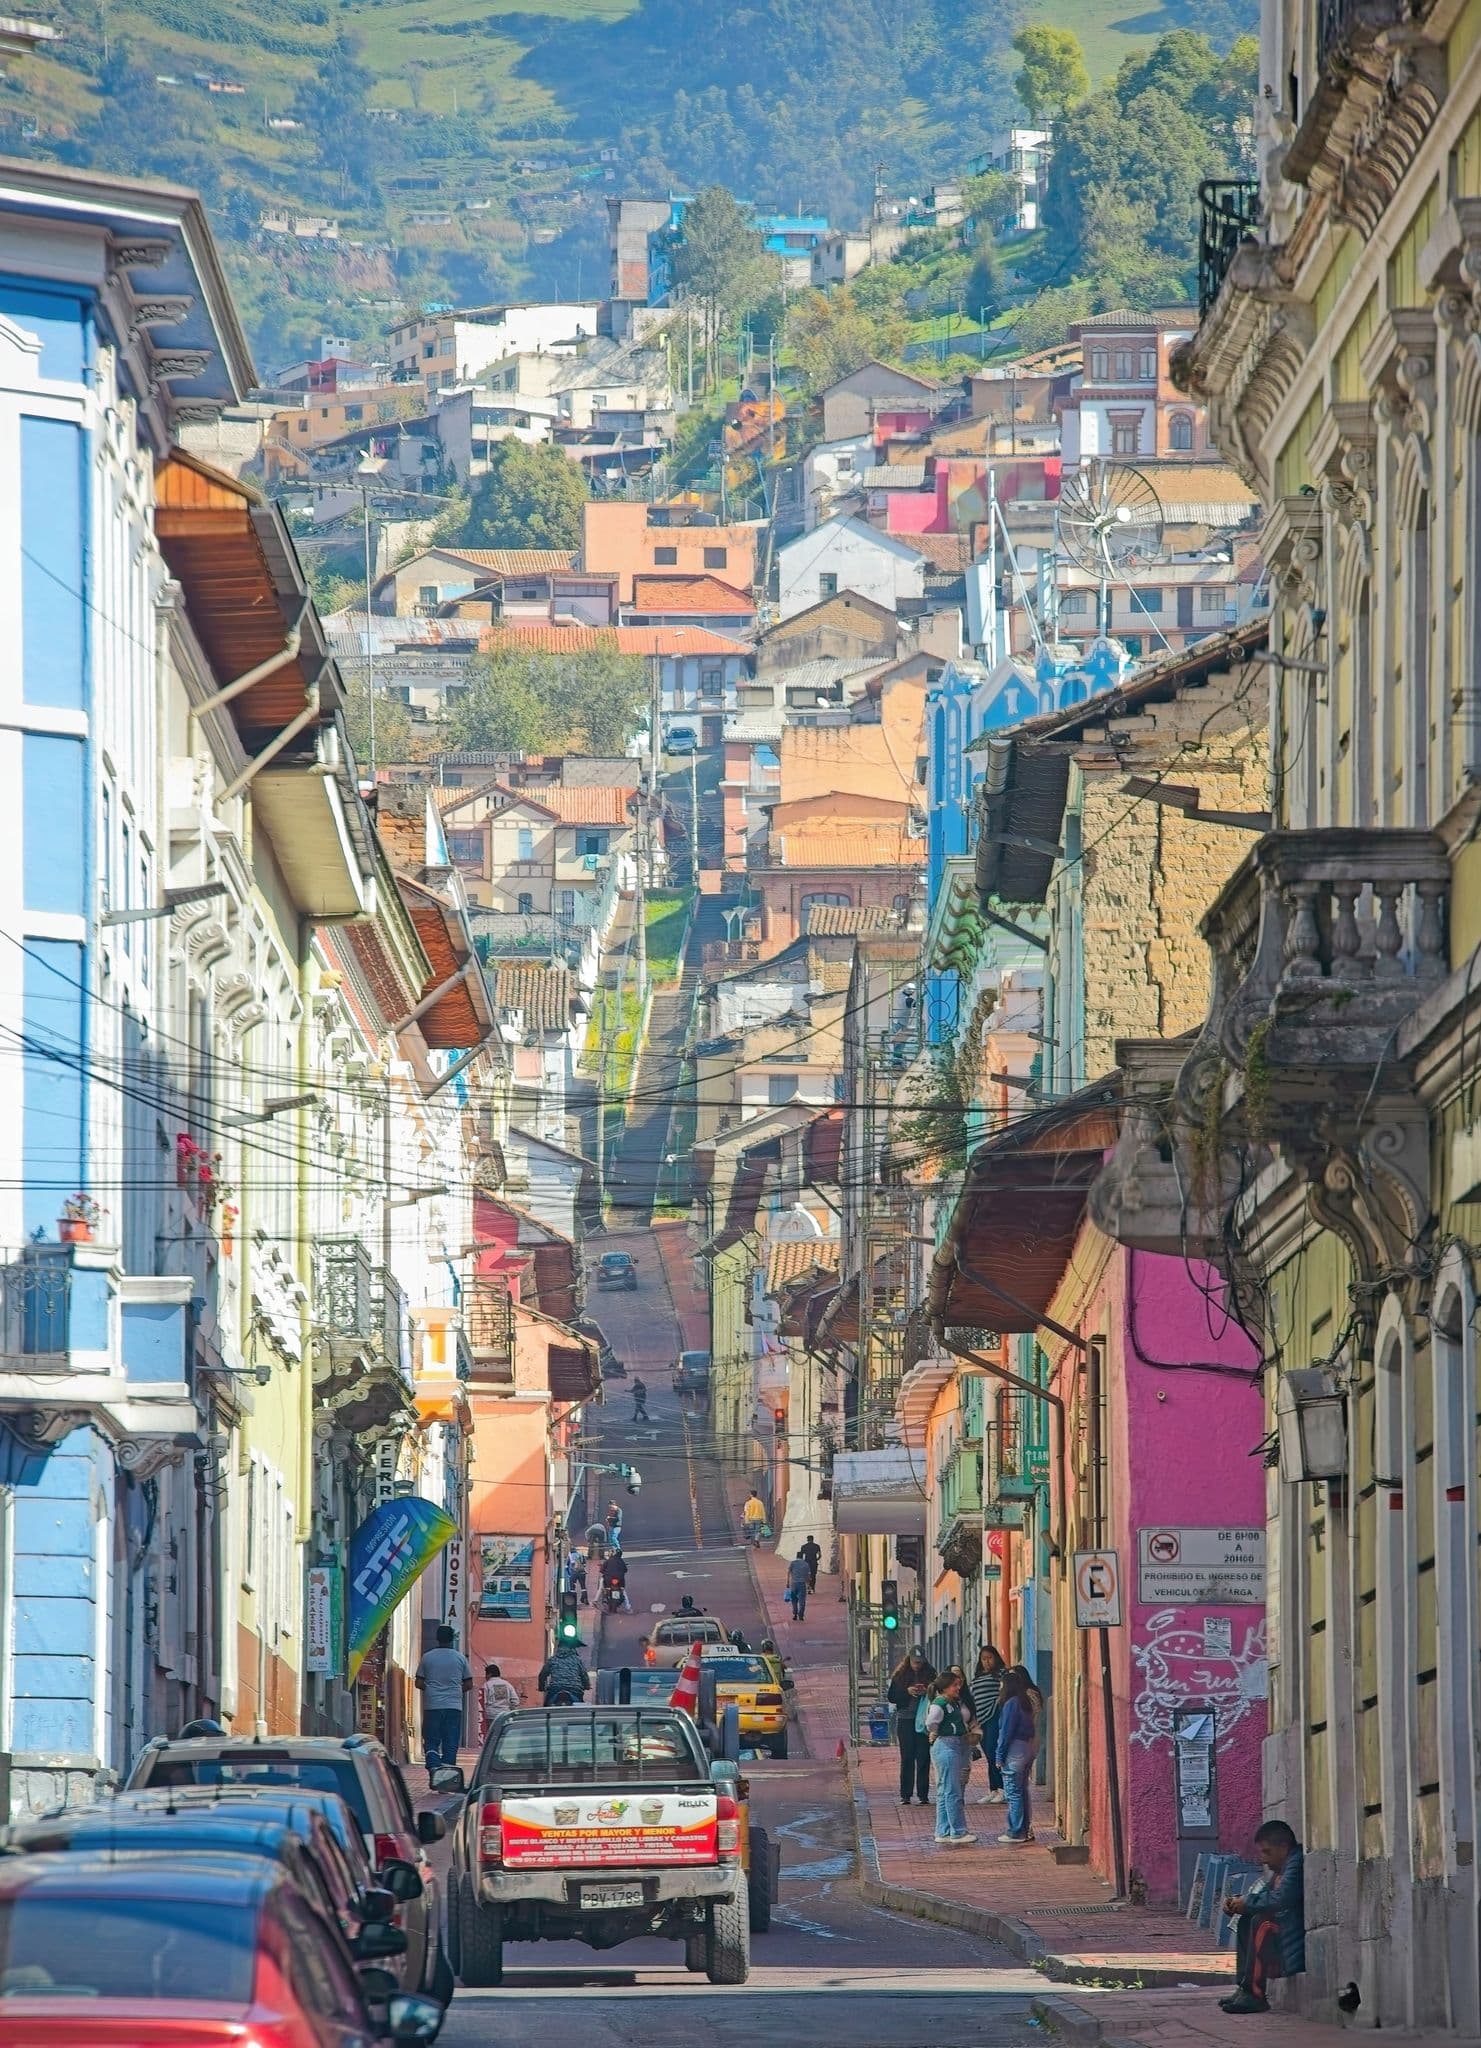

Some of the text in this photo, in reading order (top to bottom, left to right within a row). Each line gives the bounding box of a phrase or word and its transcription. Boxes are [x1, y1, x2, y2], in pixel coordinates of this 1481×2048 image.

[1218, 1532, 1233, 1541] DE
[1235, 1544, 1242, 1552] A
[353, 1514, 413, 1606] DTF
[1224, 1555, 1254, 1563] 20H00
[1144, 1572, 1263, 1580] PROHIBIDO EL INGRESO DE
[541, 1827, 676, 1838] VENTAS POR MAYOR Y MENOR
